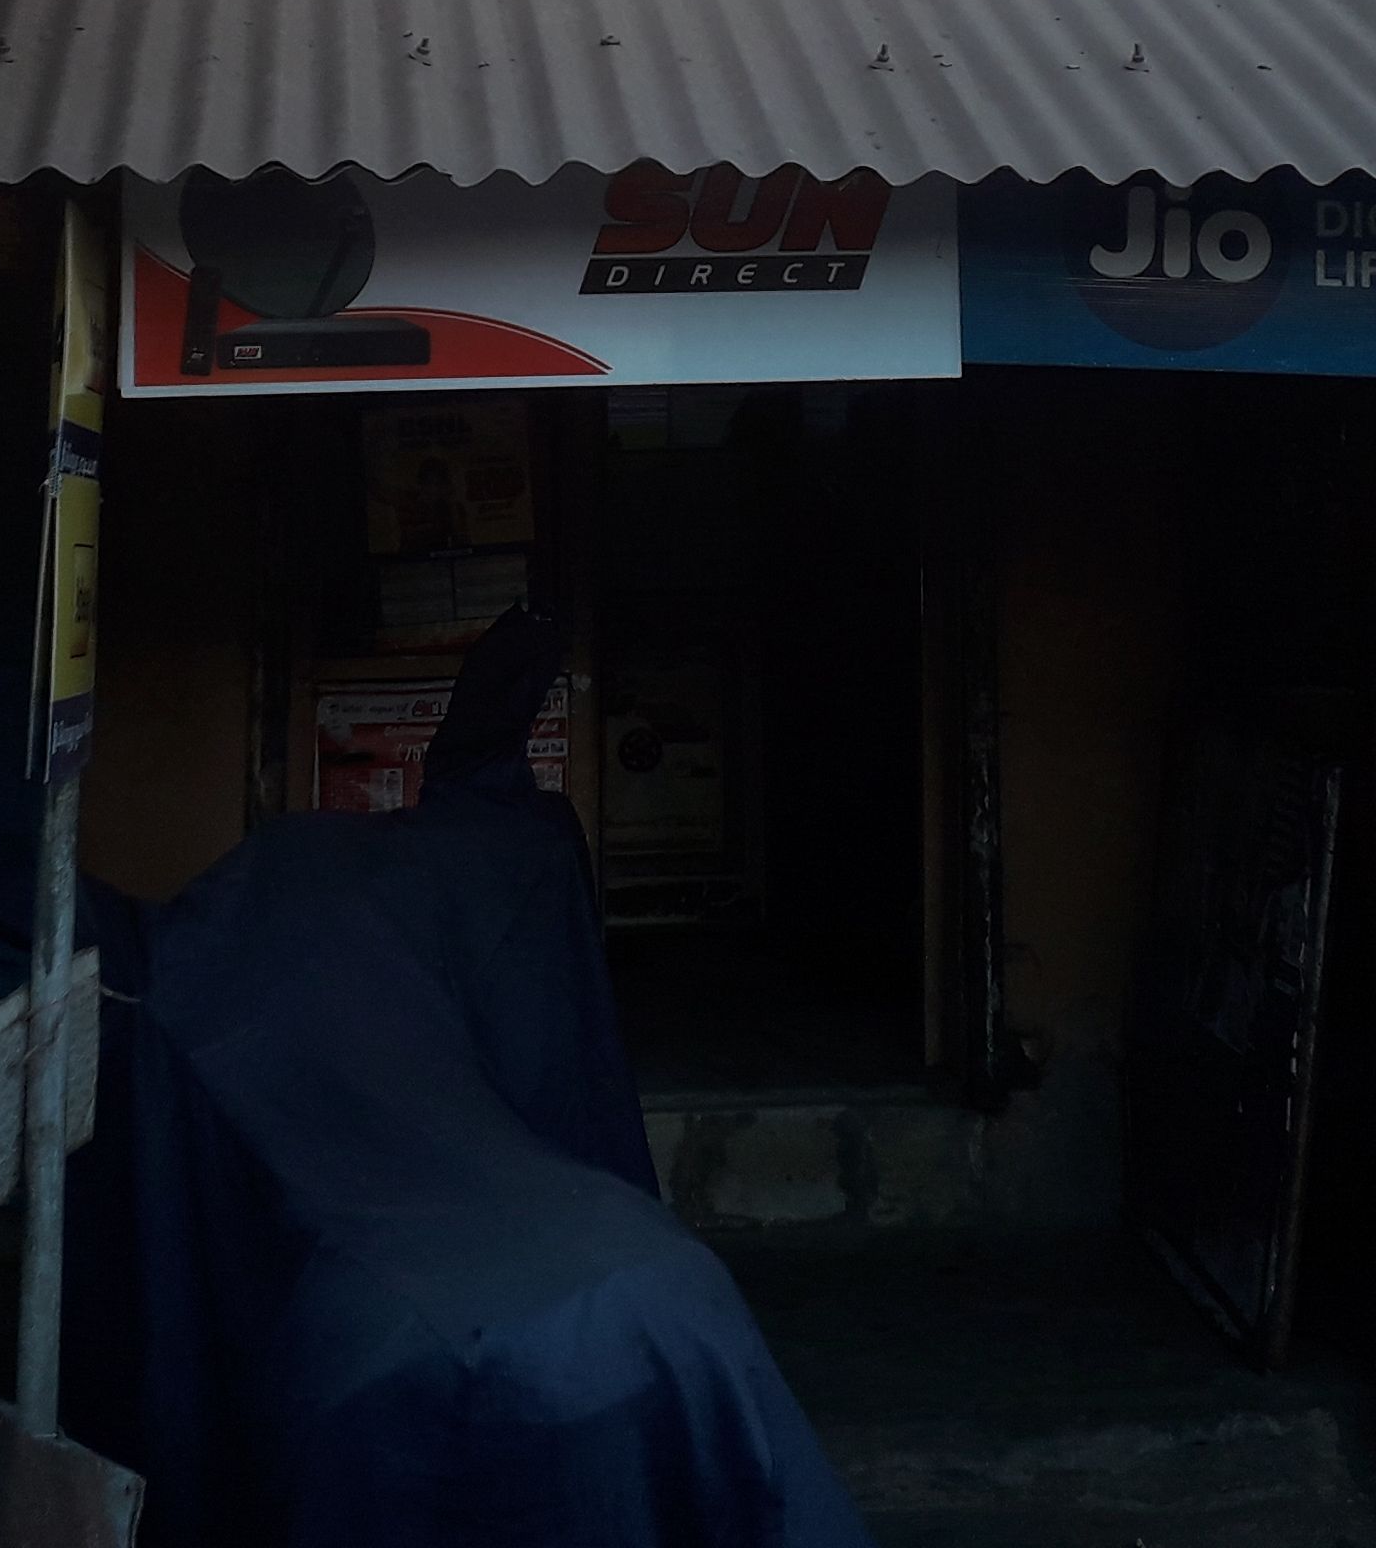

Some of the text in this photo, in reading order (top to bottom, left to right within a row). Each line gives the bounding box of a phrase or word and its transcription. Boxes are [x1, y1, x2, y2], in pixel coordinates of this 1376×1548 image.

[592, 158, 892, 254] SUN
[1089, 180, 1272, 283] Jio
[605, 262, 845, 288] DIRECT
